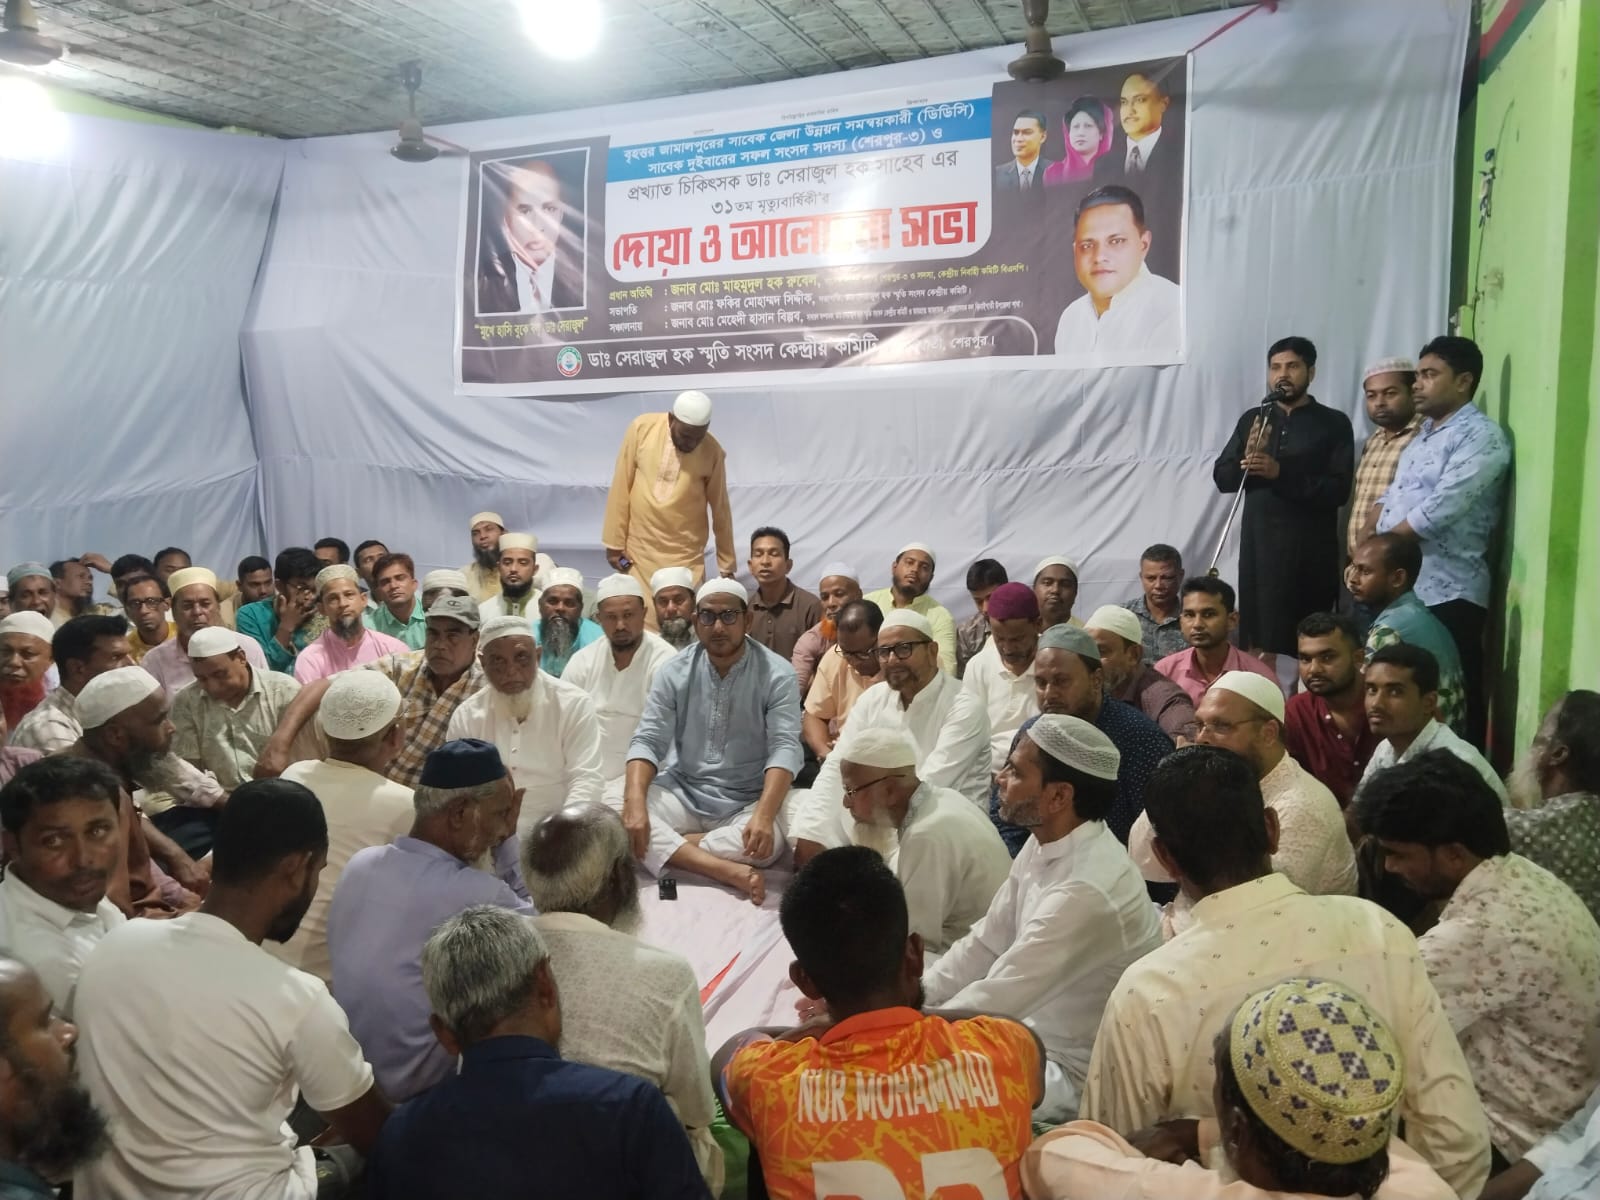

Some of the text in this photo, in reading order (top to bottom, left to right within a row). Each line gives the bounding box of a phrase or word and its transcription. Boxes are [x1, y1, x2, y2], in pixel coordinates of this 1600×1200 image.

[624, 146, 656, 164] বৃহত্তর
[660, 138, 724, 157] জামালপুরের
[728, 132, 766, 147] সাবেক
[770, 126, 800, 143] জেলা
[804, 122, 840, 138] উন্নয়ন
[917, 102, 975, 124] (ডিডিসি)
[648, 127, 943, 174] সাবেক দুইবারের সফল সংসদ সদস্য (শেরপুর-৩) ও
[628, 150, 959, 201] প্রখ্যাত চিকিৎসক ডাঃ সেরাজুল হক সাহেব এর
[613, 227, 693, 277] দোয়া
[700, 224, 721, 263] ও
[900, 202, 978, 248] সভা
[609, 304, 638, 317] সভাপতি
[670, 300, 692, 313] জনাব
[696, 298, 714, 312] মোঃ
[716, 296, 741, 311] ফকির
[744, 295, 781, 308] মোহাম্মদ
[629, 286, 653, 299] অতিথি
[670, 282, 696, 297] জনাব
[700, 280, 720, 295] মোঃ
[723, 277, 764, 295] মাহমুদুল
[766, 276, 783, 290] হক
[497, 322, 512, 339] হাসি
[514, 324, 528, 340] বুকে
[670, 318, 693, 330] জনাব
[696, 316, 714, 328] মোঃ
[716, 311, 746, 327] মেহেদী
[748, 312, 774, 326] হাসান
[587, 350, 611, 369] ডাঃ
[615, 348, 668, 370] সেরাজুল
[672, 346, 695, 366] হক
[698, 340, 730, 370] স্মৃতি
[734, 343, 775, 362] সংসদ
[780, 336, 828, 360] কেন্দ্রীয়
[835, 332, 879, 356] কমিটি
[798, 1050, 1000, 1124] NUR MOHAMMAD
